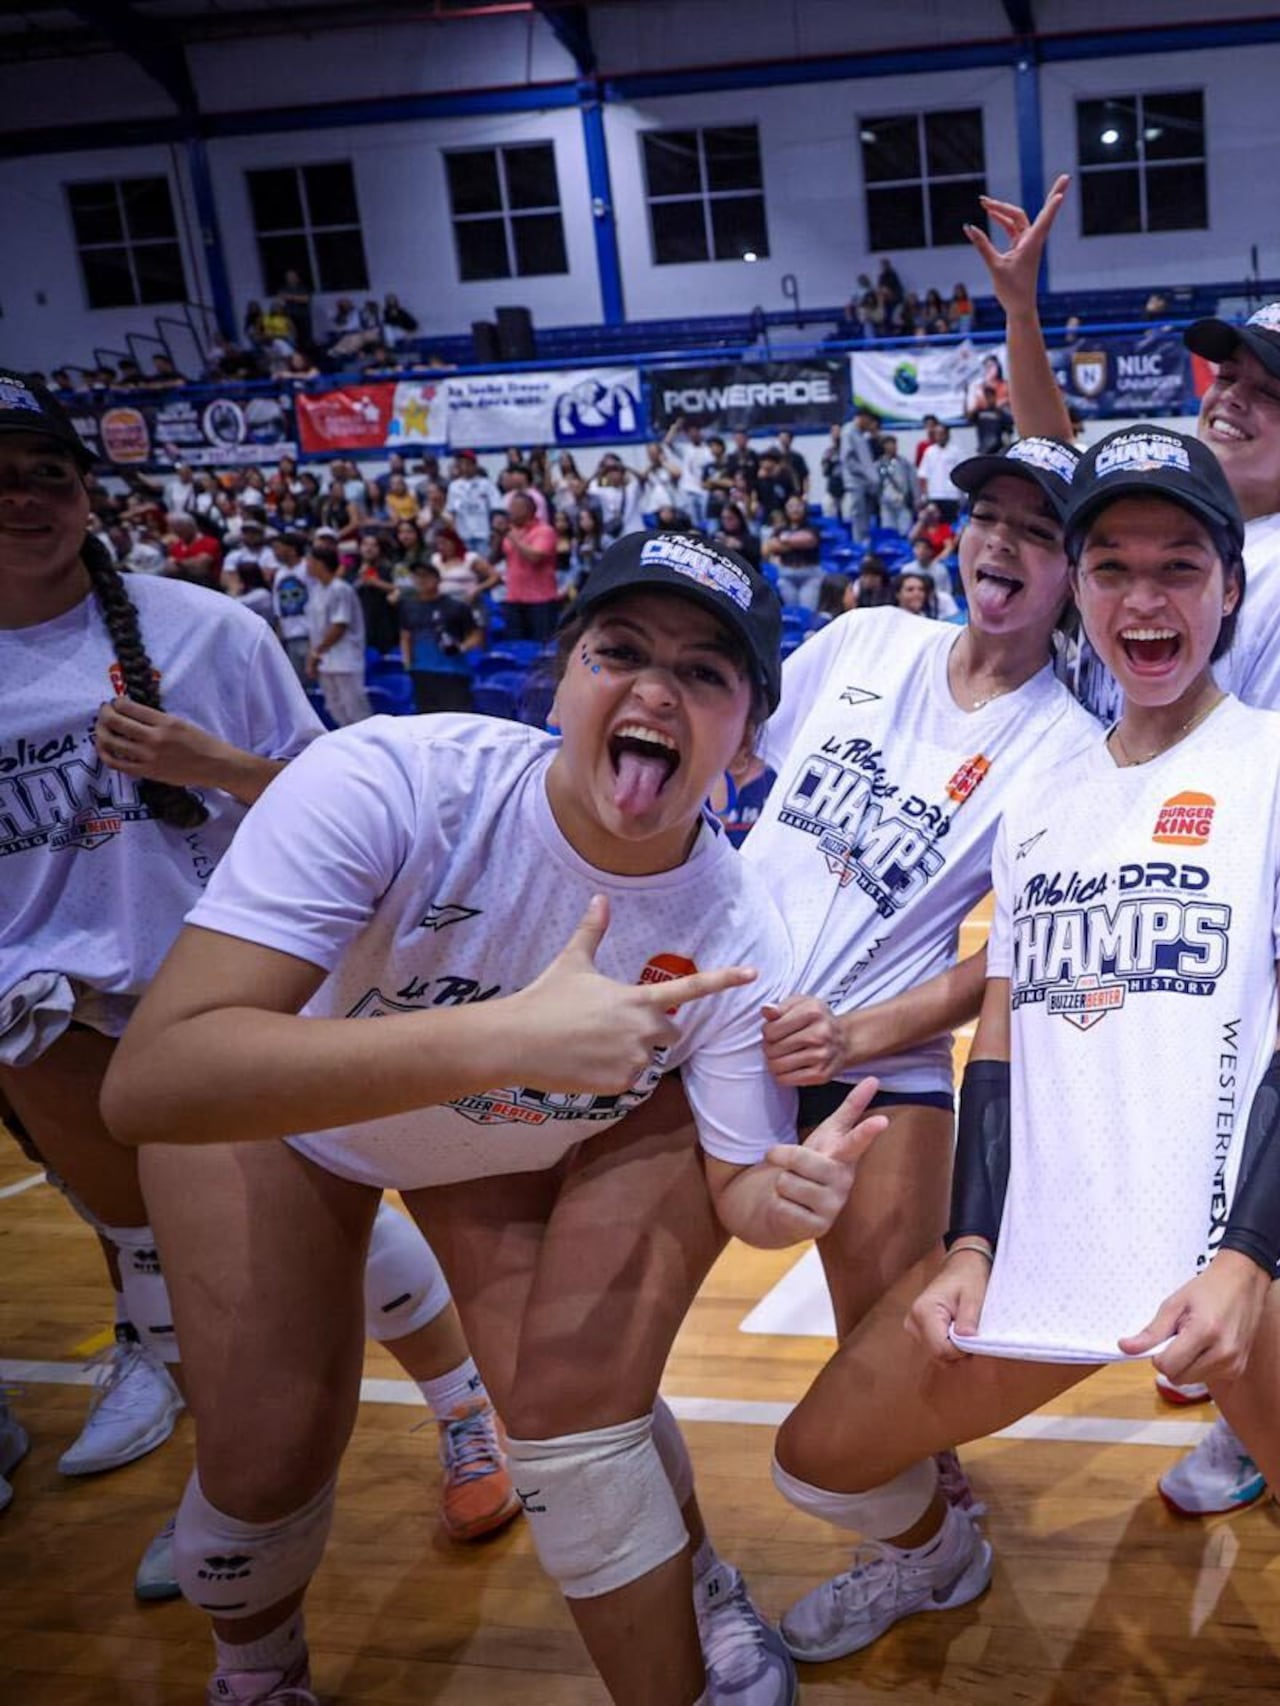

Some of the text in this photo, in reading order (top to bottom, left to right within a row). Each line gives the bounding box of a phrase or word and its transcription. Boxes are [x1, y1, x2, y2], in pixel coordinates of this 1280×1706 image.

[1117, 355, 1162, 376] NUC
[663, 379, 832, 414] POWERADE
[1095, 441, 1190, 475] CHAMPS
[640, 539, 753, 607] CHAMPS
[1158, 806, 1214, 820] BURGER
[783, 754, 947, 910] CHAMPS
[1154, 818, 1212, 837] KING
[1119, 862, 1210, 890] DRD
[1013, 897, 1232, 991] HAMPS
[1020, 989, 1045, 1004] ING
[1130, 980, 1213, 994] HISTORY
